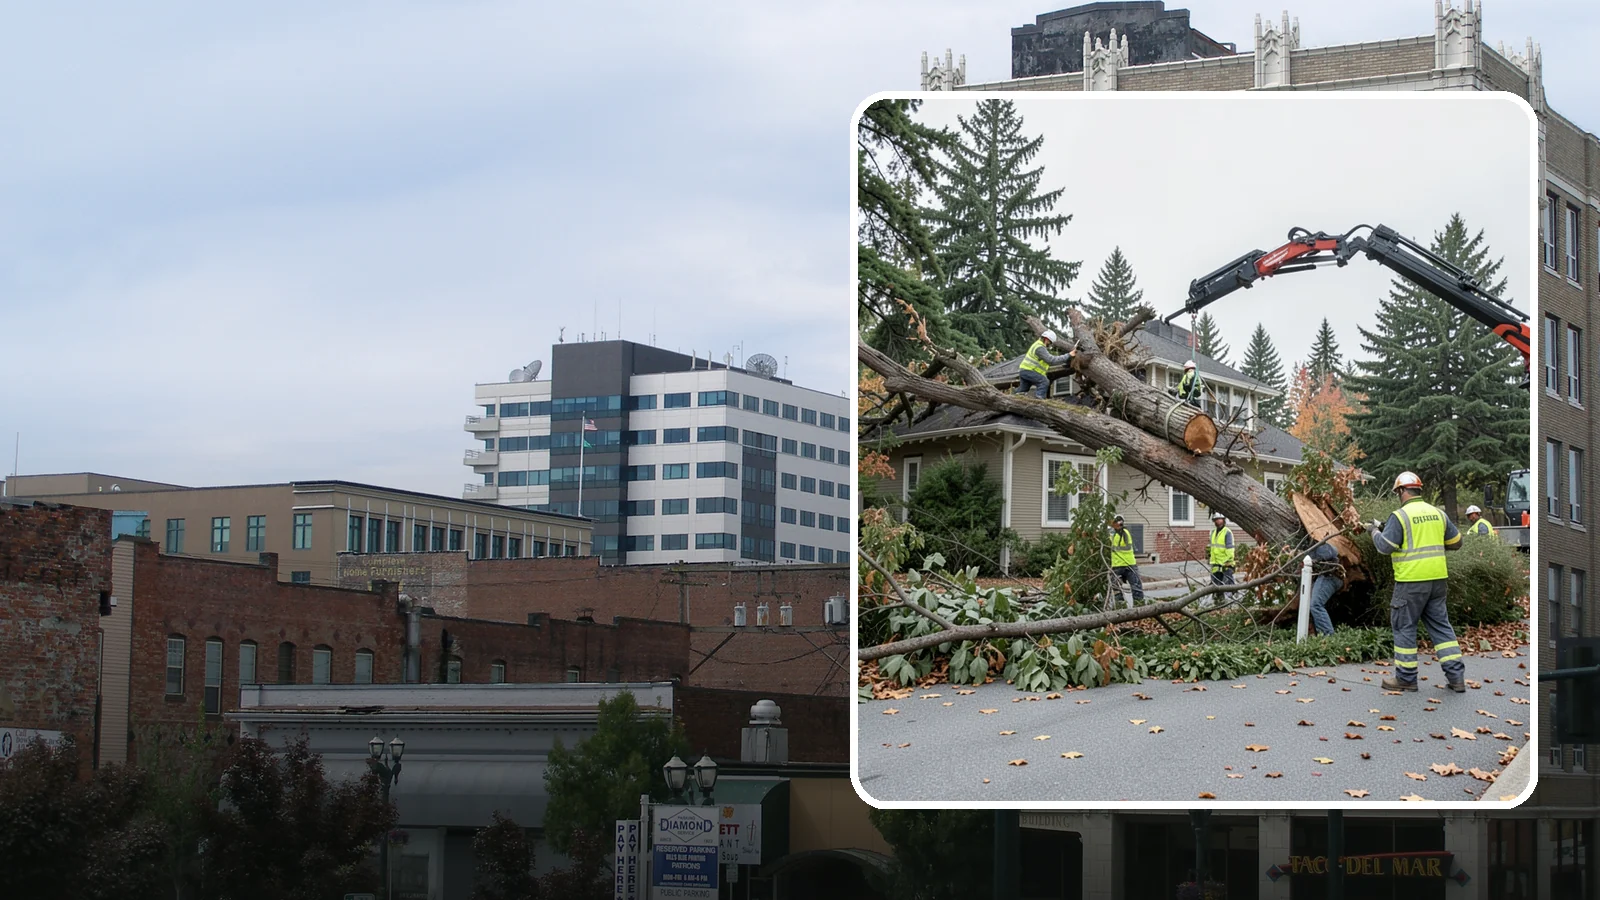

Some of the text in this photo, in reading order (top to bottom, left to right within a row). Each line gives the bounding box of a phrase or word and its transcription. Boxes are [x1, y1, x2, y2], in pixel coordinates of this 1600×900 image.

[660, 818, 713, 832] DIAMOND
[1022, 814, 1070, 828] BUILDING
[616, 825, 625, 893] PAY HERE
[628, 824, 637, 893] PAY HERE
[721, 851, 739, 863] Soup
[671, 862, 701, 870] PATRONS
[1346, 856, 1384, 875] DEL
[1392, 857, 1442, 877] MAR
[660, 888, 710, 898] PUBLIC PARKING
